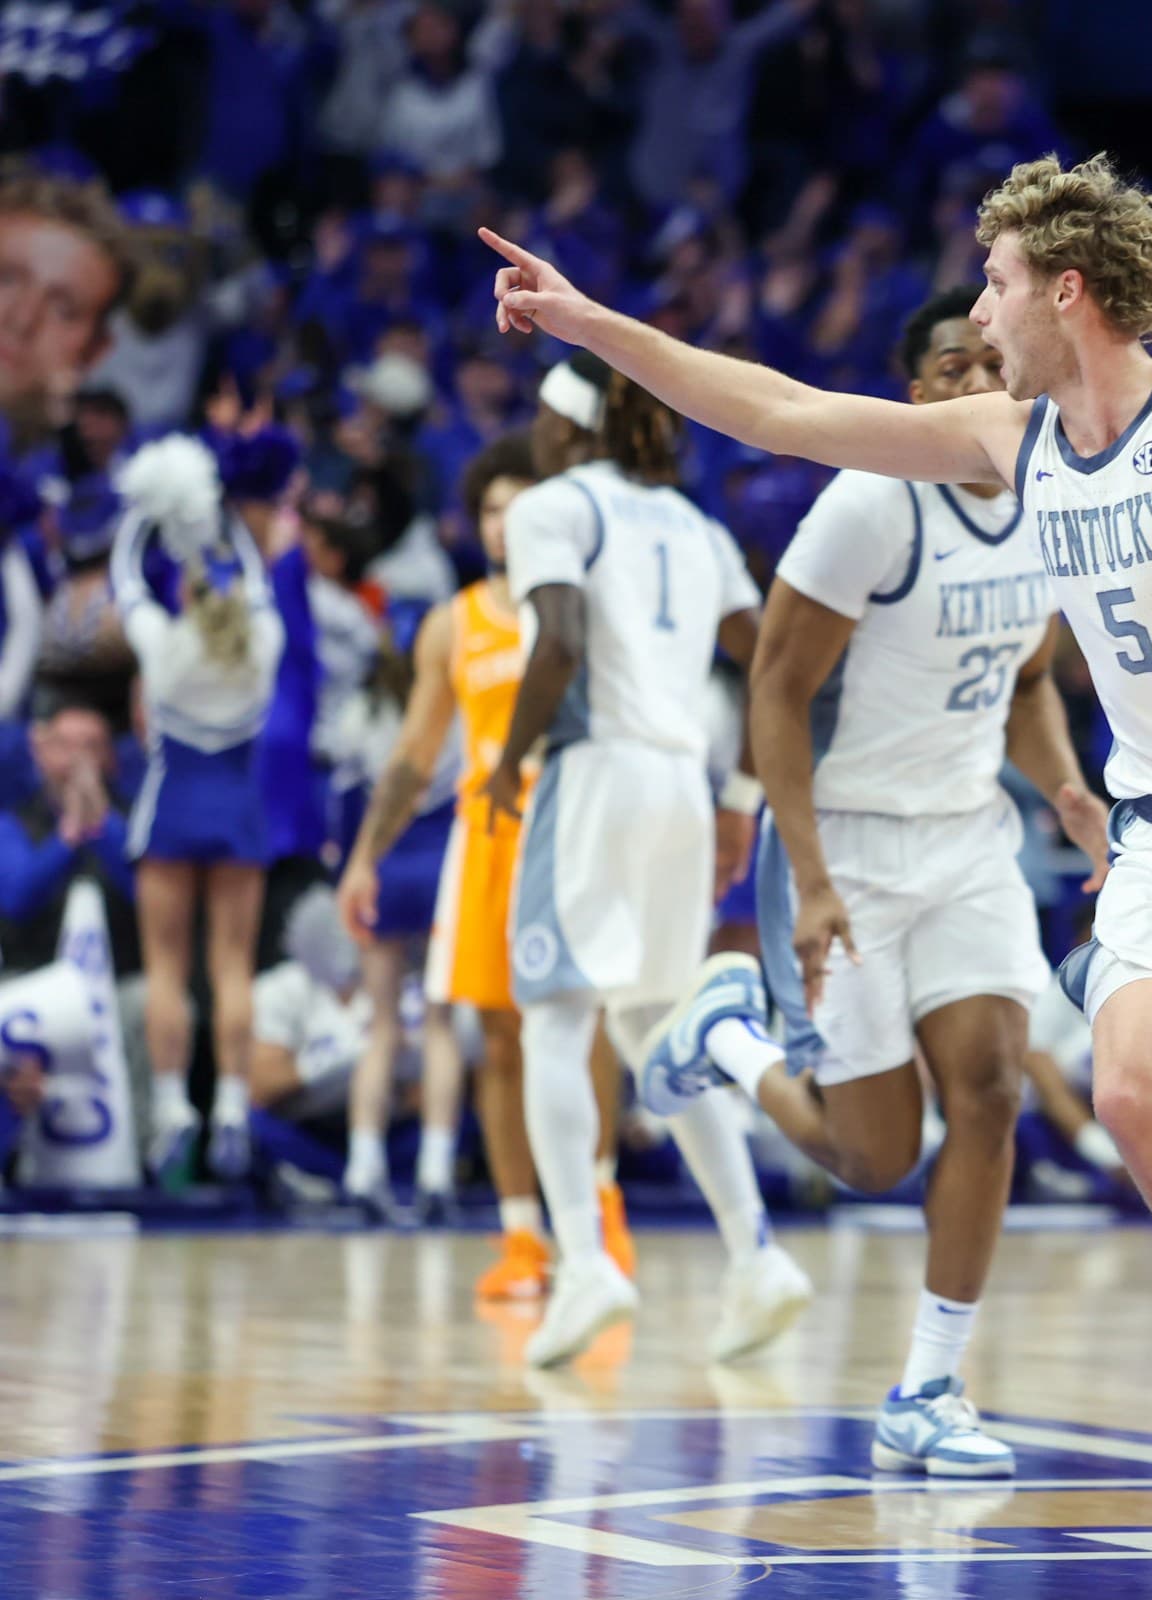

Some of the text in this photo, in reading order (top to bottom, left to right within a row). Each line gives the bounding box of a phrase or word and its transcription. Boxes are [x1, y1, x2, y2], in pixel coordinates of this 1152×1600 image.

[654, 540, 677, 631] 1
[936, 569, 1046, 637] KENTUCK
[944, 642, 1023, 711] 23
